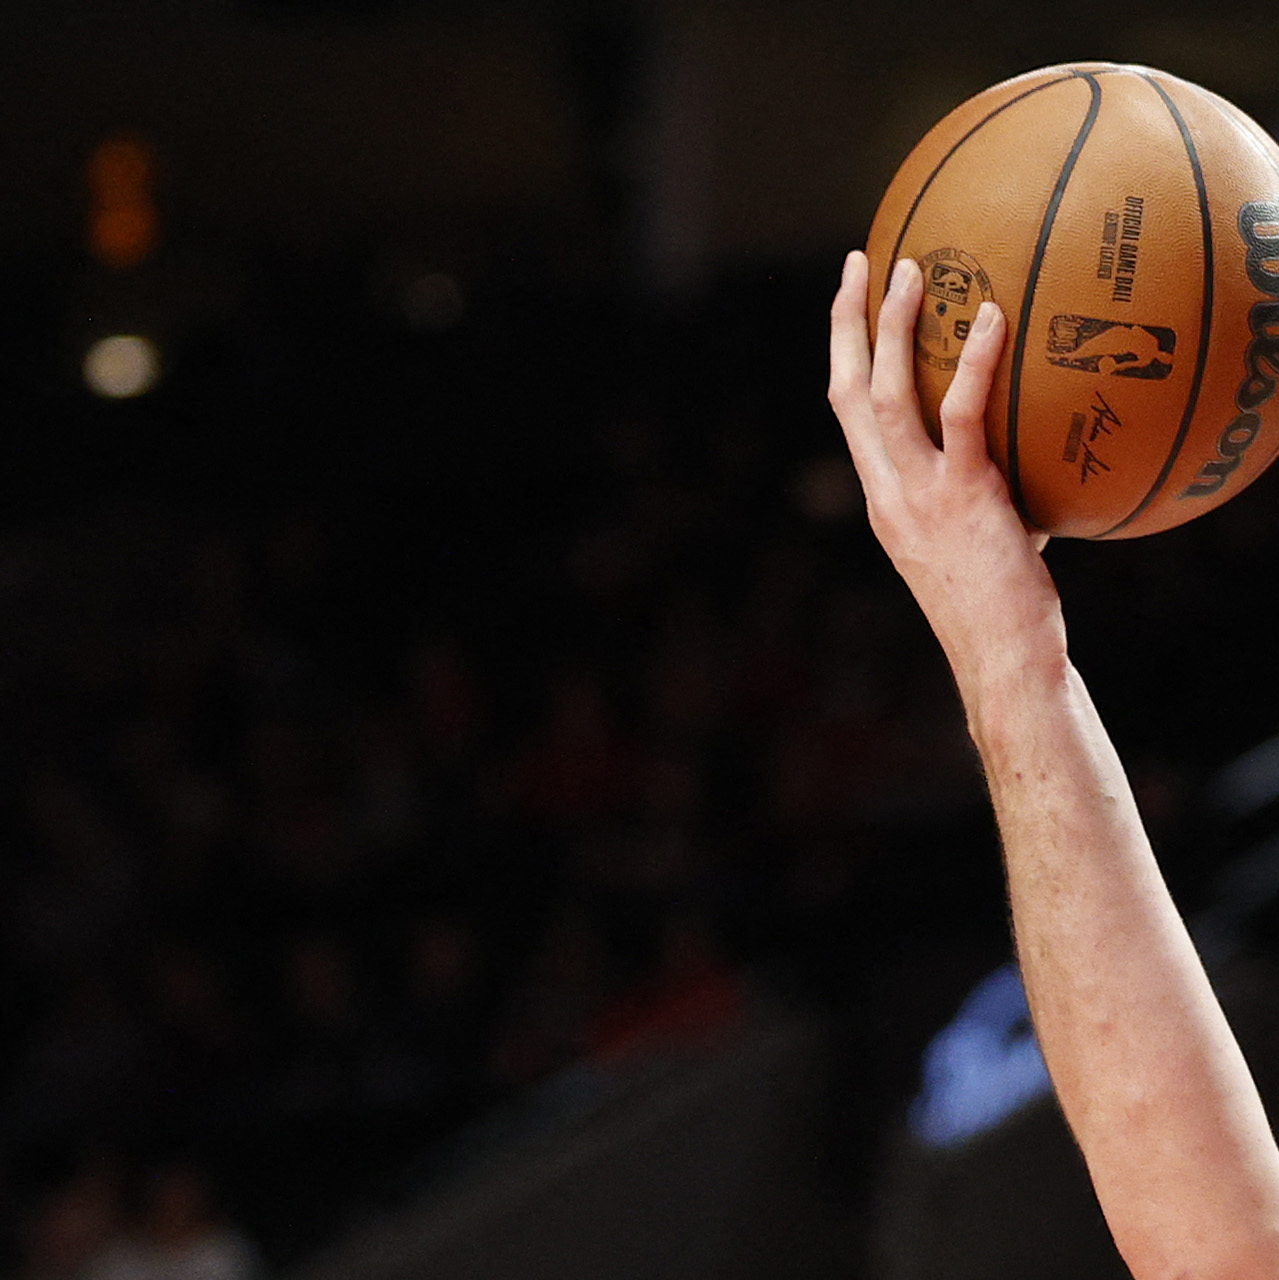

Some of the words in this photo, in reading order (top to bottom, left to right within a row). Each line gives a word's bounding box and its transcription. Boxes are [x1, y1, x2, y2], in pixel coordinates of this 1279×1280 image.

[1120, 196, 1145, 241] OFFICIAL
[1117, 243, 1139, 275] GAME
[1112, 276, 1134, 302] BALL
